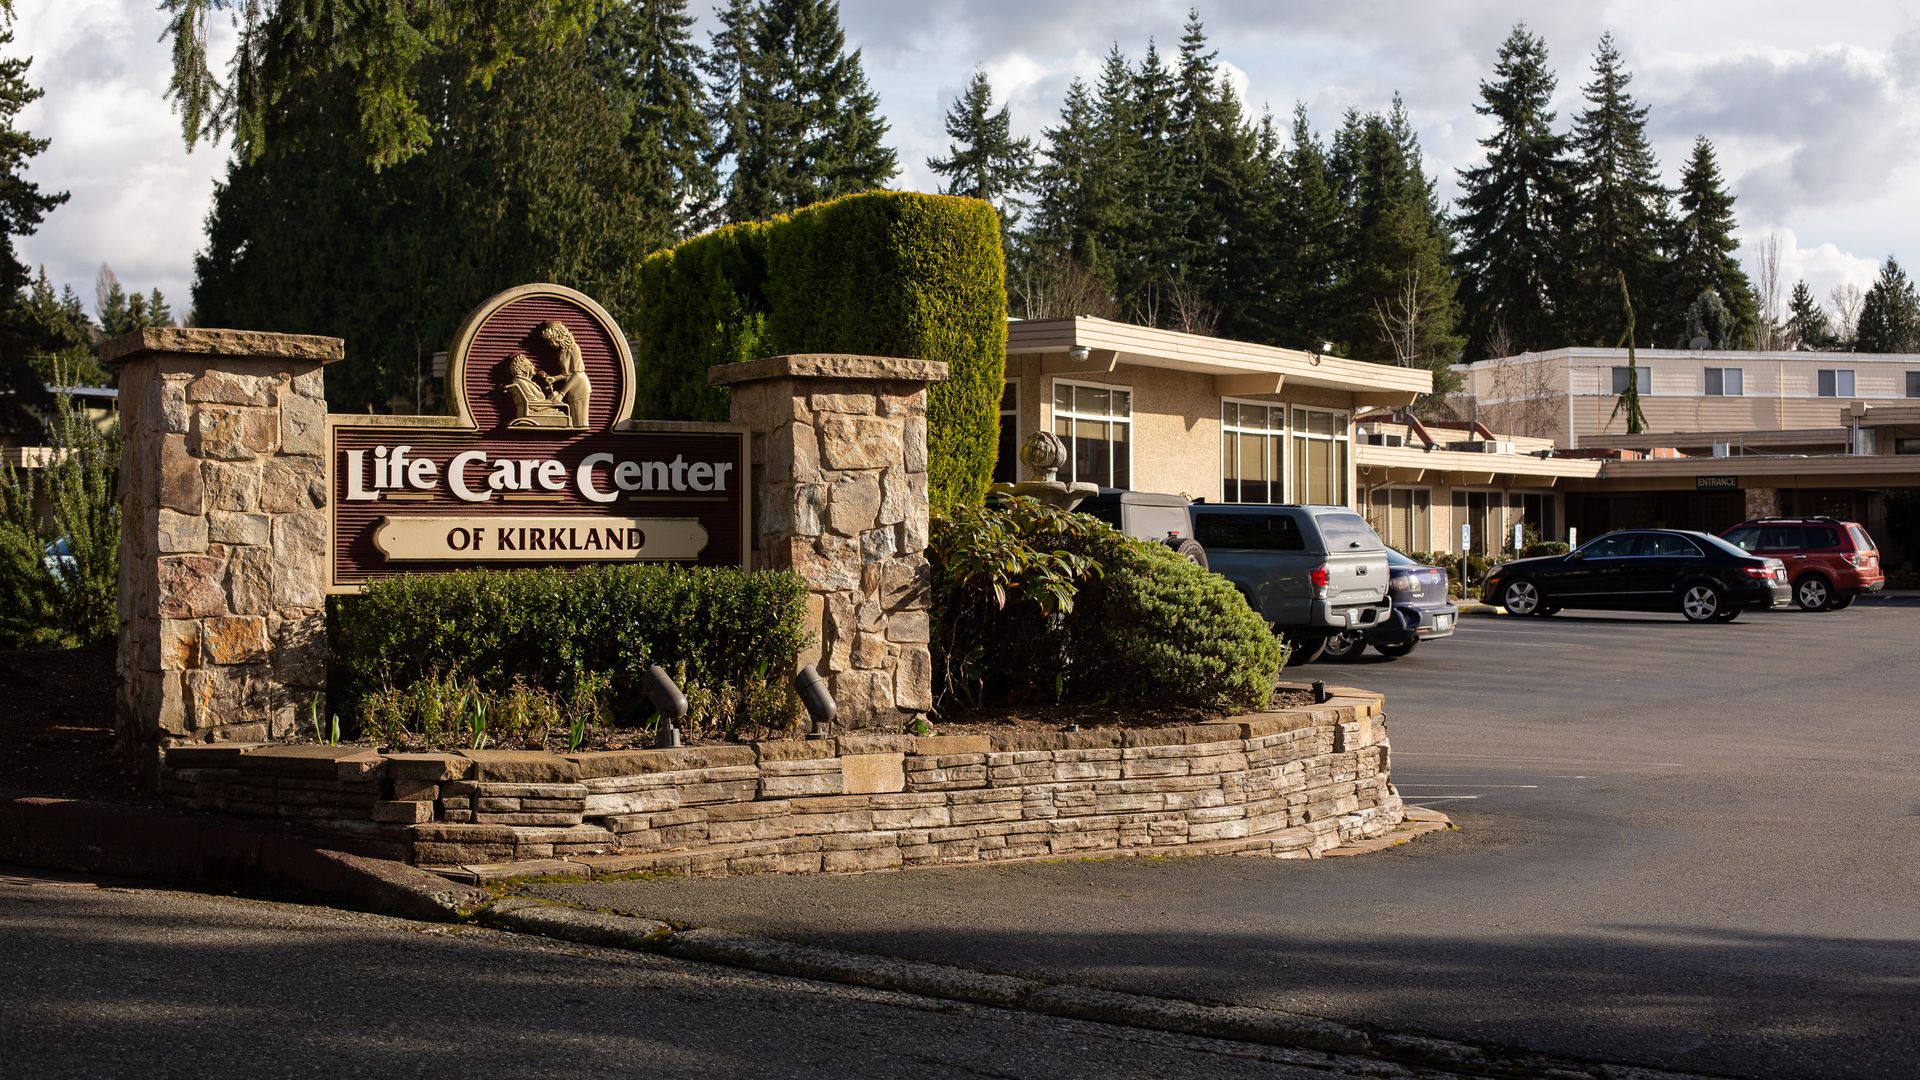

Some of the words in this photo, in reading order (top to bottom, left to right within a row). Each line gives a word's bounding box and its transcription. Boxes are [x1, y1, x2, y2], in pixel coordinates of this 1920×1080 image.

[345, 445, 438, 500] Life
[448, 450, 566, 502] Care
[577, 453, 733, 503] Center
[1697, 477, 1737, 487] ENTRANCE
[446, 527, 485, 551] OF
[498, 527, 646, 550] KIRKLAND
